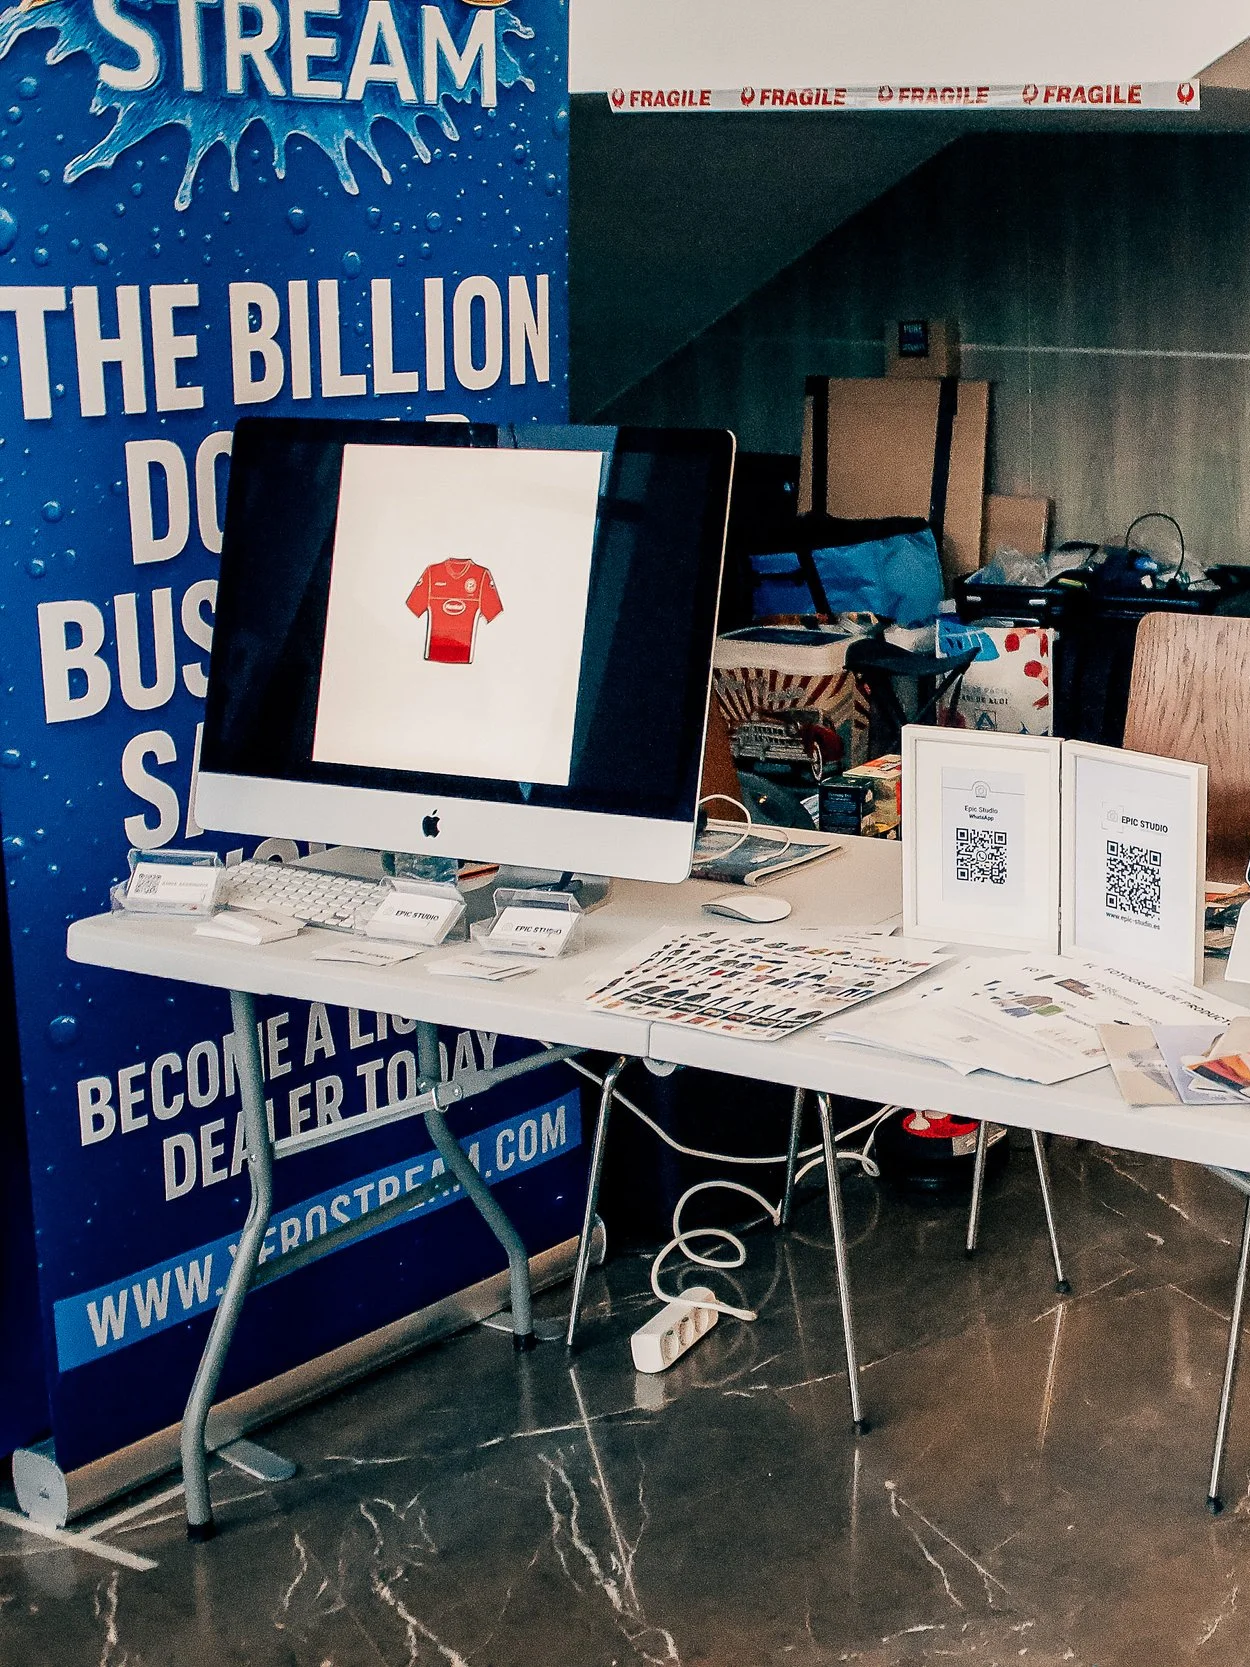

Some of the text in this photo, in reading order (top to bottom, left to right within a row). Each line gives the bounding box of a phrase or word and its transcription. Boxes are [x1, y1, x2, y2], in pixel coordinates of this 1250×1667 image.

[95, 0, 498, 108] STREAM
[629, 84, 1142, 107] FRAGILE FRAGILE FRAGILE FRAGILE
[0, 273, 550, 421] THE BILLION
[964, 805, 999, 815] Epic Studio
[968, 814, 995, 822] WhatsApp
[1121, 815, 1169, 834] EPIC STUDIO
[395, 910, 440, 922] EPIC STUDIO
[514, 925, 533, 933] EPIC
[1181, 1000, 1232, 1027] PRODUCT
[304, 1001, 337, 1067] A
